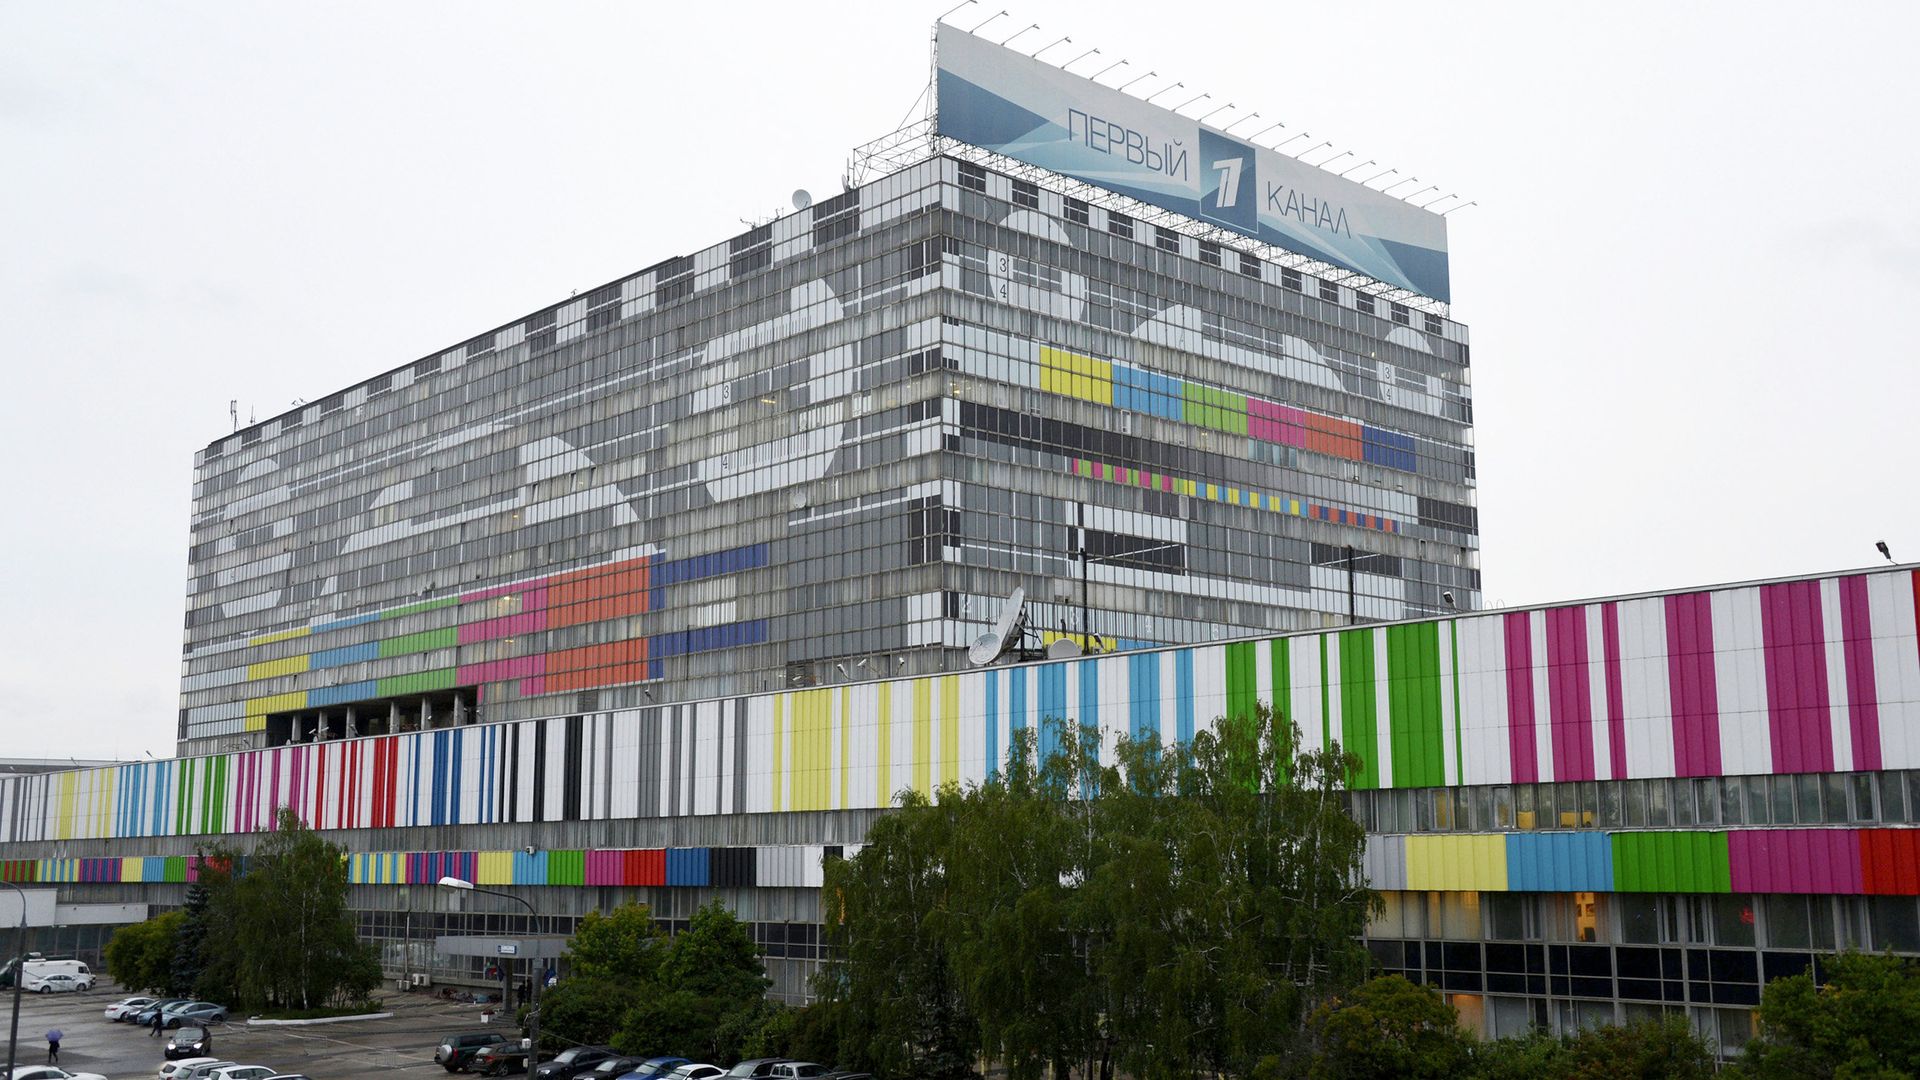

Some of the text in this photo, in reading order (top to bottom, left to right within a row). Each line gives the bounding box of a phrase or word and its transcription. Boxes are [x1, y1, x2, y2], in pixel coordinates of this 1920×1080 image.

[1068, 108, 1352, 240] ПЕРВЫЙ 1 КАНАЛ
[1000, 257, 1007, 273] 3
[1000, 284, 1007, 298] 4
[1385, 366, 1391, 380] 3
[723, 384, 730, 399] 3
